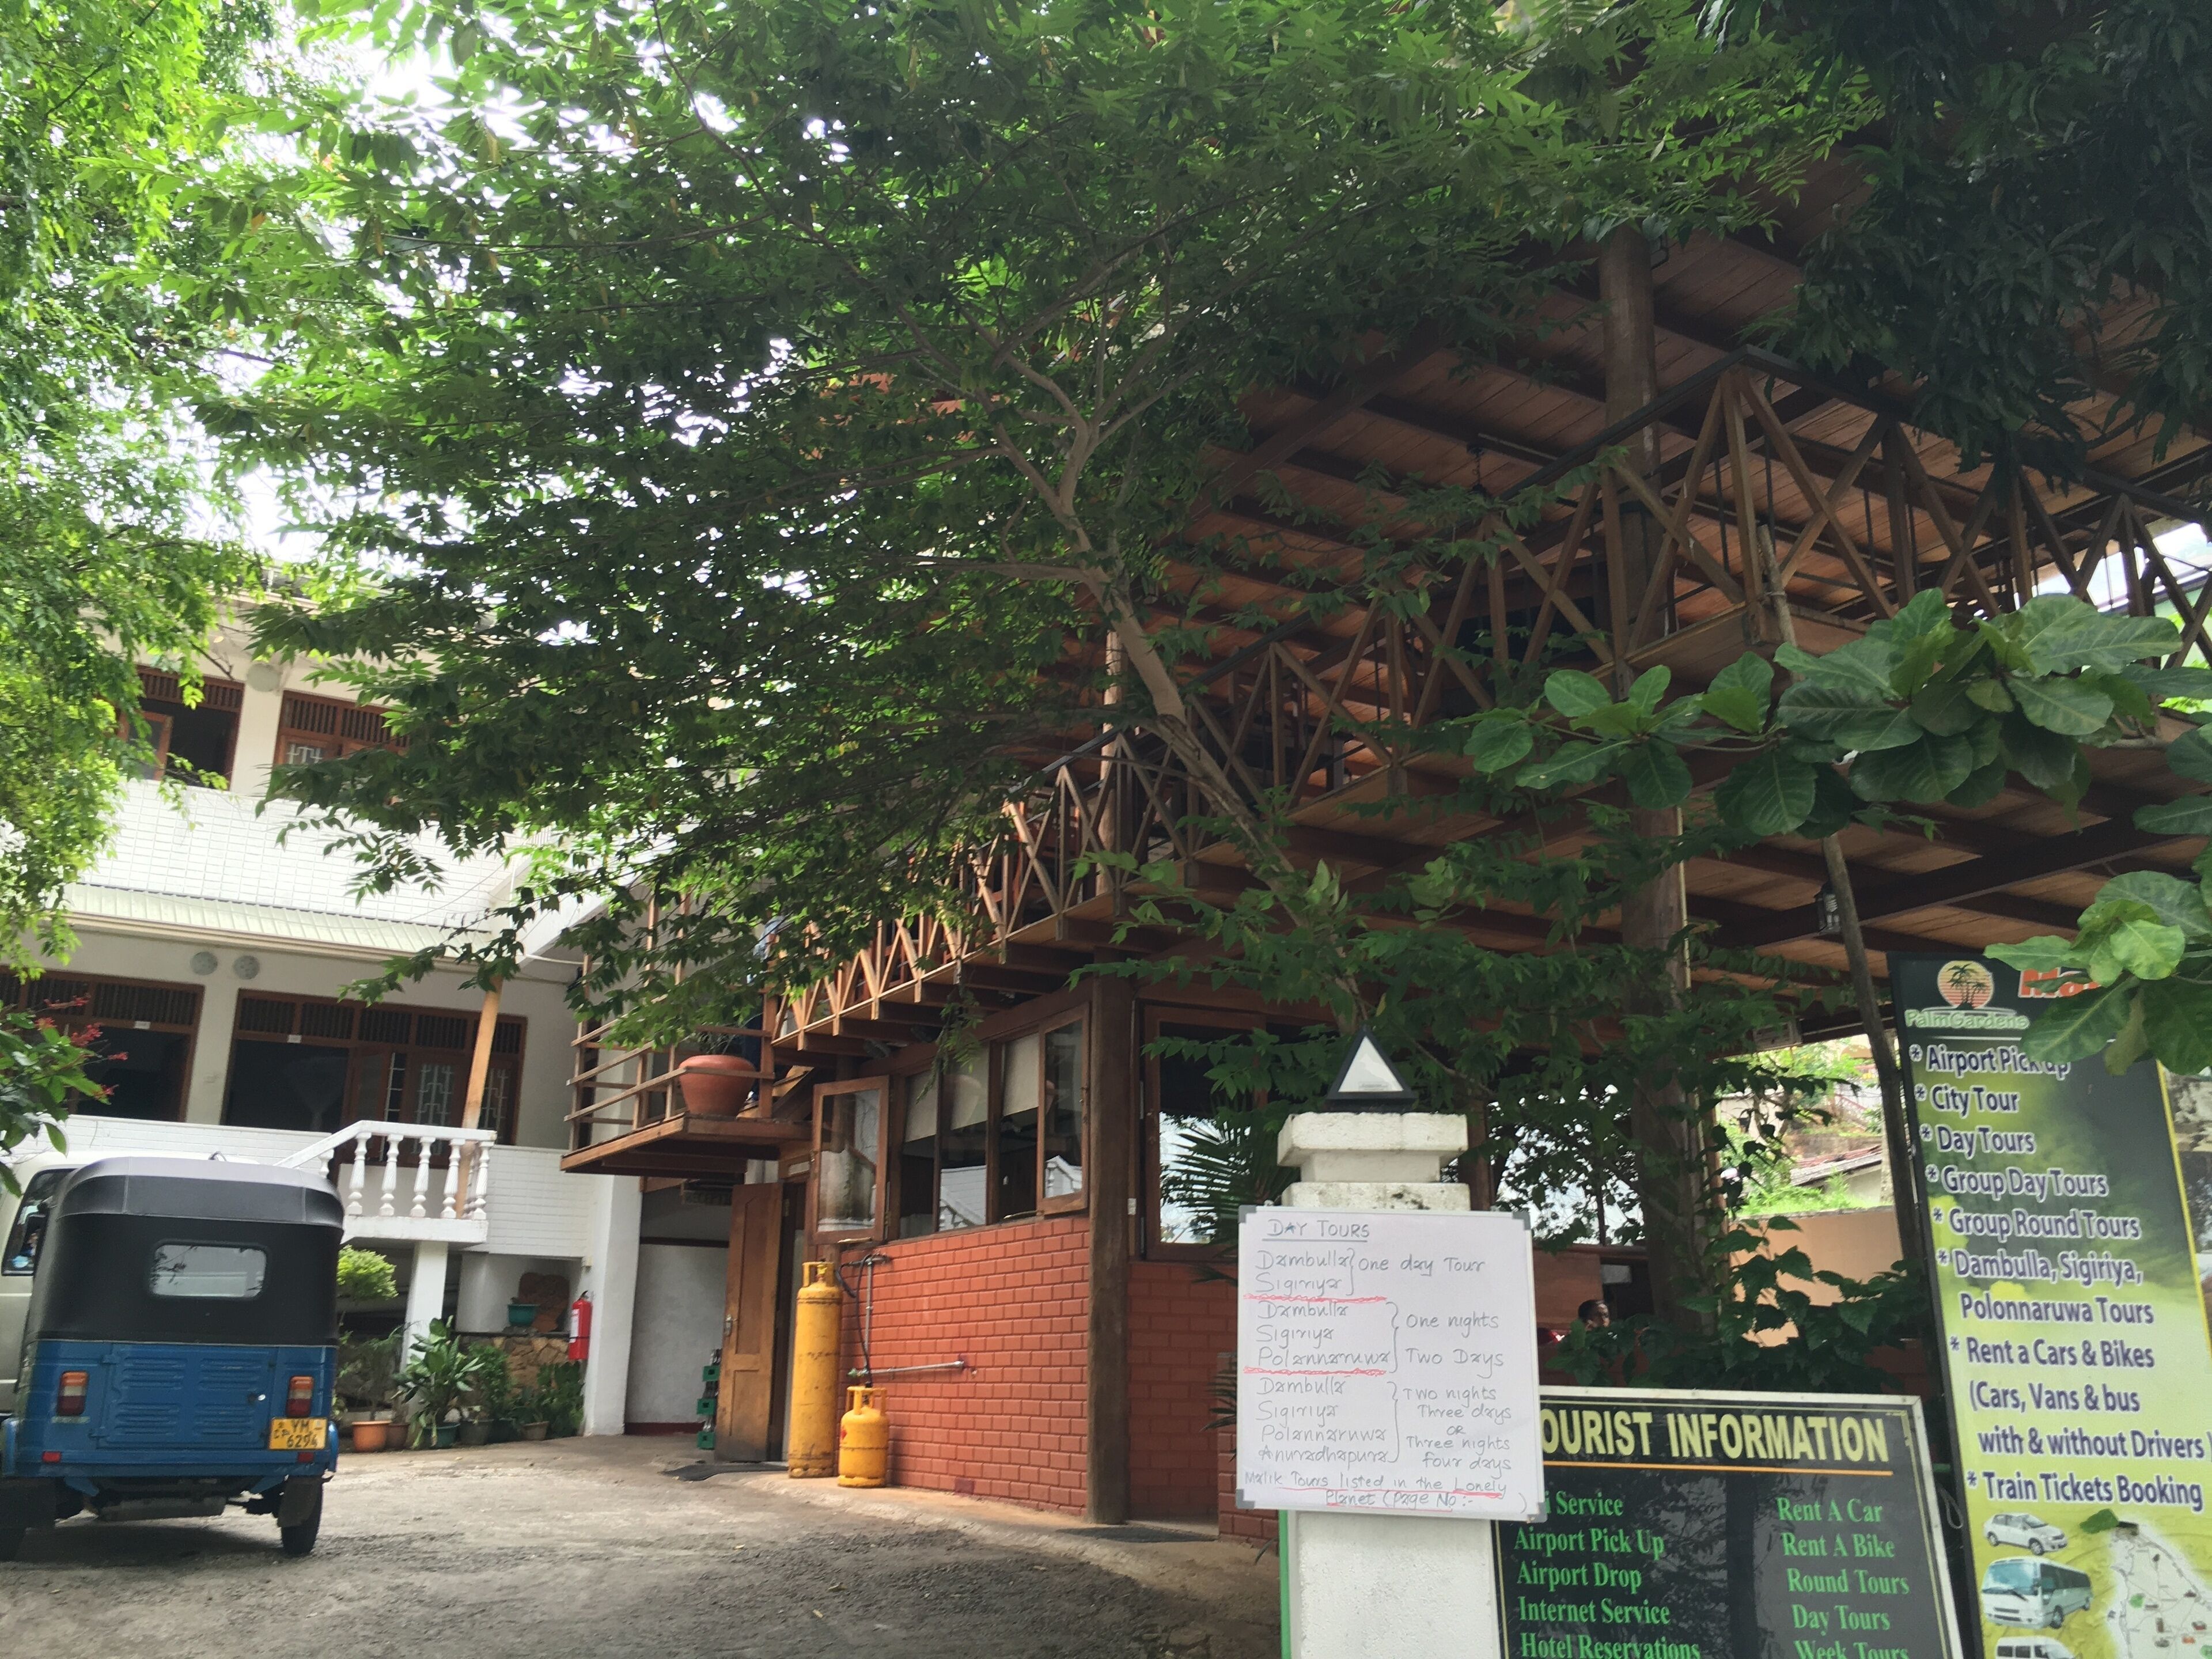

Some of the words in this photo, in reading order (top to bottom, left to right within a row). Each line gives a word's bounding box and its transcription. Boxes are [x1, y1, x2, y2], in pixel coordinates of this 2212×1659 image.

[1926, 1044, 1997, 1078] Airport
[1931, 1084, 1969, 1118] City
[1971, 1085, 2020, 1112] Tour
[1936, 1124, 1975, 1158] Day
[1977, 1126, 2036, 1153] Tours
[1942, 1166, 2005, 1200] Group
[2007, 1167, 2047, 1202] Day
[2048, 1168, 2108, 1196] Tours
[1267, 1219, 1307, 1236] DAY
[1317, 1219, 1369, 1237] TOURS
[1949, 1208, 2011, 1242] Group
[2013, 1209, 2081, 1237] Round
[2082, 1211, 2141, 1238] Tours
[1255, 1250, 1350, 1270] Dambulla
[1400, 1254, 1433, 1277] day
[1444, 1257, 1485, 1271] Tour
[1953, 1249, 2057, 1283] Dambulla,
[2059, 1251, 2143, 1287] Sigiriya,
[1257, 1300, 1349, 1319] Dambulla
[1961, 1291, 2093, 1321] Polonnaruwa
[2094, 1297, 2154, 1324] Tours
[1406, 1314, 1439, 1328] One
[1449, 1311, 1498, 1338] nights
[1405, 1348, 1442, 1364] Two
[1453, 1349, 1503, 1378] Days
[1966, 1336, 2014, 1363] Rent
[2018, 1345, 2029, 1363] a
[2033, 1339, 2077, 1366] Cars
[2081, 1339, 2097, 1366] &
[2100, 1339, 2155, 1367] Bikes
[1256, 1376, 1346, 1395] Dambulla
[1446, 1386, 1496, 1408] nights
[1969, 1380, 2026, 1412] (Cars,
[2028, 1382, 2080, 1410] Vans
[2084, 1384, 2099, 1410] &
[2102, 1383, 2140, 1411] bus
[1418, 1404, 1464, 1417] Three
[1471, 1403, 1512, 1425] days
[1407, 1435, 1453, 1449] Three
[1463, 1435, 1510, 1456] nights
[1541, 1409, 1652, 1456] OURIST
[1666, 1412, 1889, 1462] INFORMATION
[1978, 1425, 2024, 1454] with
[2028, 1427, 2044, 1454] &
[2047, 1427, 2128, 1456] without
[2130, 1429, 2205, 1458] Drivers
[1469, 1457, 1512, 1479] days
[1245, 1471, 1283, 1484] Malik
[1291, 1471, 1328, 1487] Tours
[1340, 1472, 1383, 1488] listed
[1394, 1479, 1406, 1487] in
[1416, 1476, 1442, 1489] the
[1455, 1478, 1506, 1499] Lonely
[1325, 1489, 1375, 1505] Planet
[1982, 1471, 2037, 1500] Train
[2039, 1472, 2113, 1502] Tickets
[2116, 1474, 2203, 1512] Booking
[1556, 1491, 1623, 1516] Service
[1775, 1497, 1822, 1521] Rent
[1828, 1498, 1843, 1521] A
[1847, 1498, 1883, 1522] Car
[1514, 1526, 1585, 1557] Airport
[1589, 1528, 1632, 1552] Pick
[1636, 1529, 1665, 1560] Up
[1781, 1532, 1828, 1556] Rent
[1833, 1533, 1849, 1556] A
[1852, 1533, 1895, 1558] Bike
[1517, 1560, 1588, 1592] Airport
[1593, 1562, 1641, 1594] Drop
[1786, 1568, 1849, 1592] Round
[1853, 1569, 1910, 1594] Tours
[1517, 1596, 1596, 1622] Internet
[1600, 1598, 1671, 1624] Service
[1791, 1604, 1829, 1636] Day
[1834, 1605, 1891, 1630] Tours
[1520, 1633, 1573, 1658] Hotel
[1577, 1634, 1700, 1659] Reservations
[1793, 1641, 1847, 1659] Week
[1853, 1642, 1910, 1659] Tours
